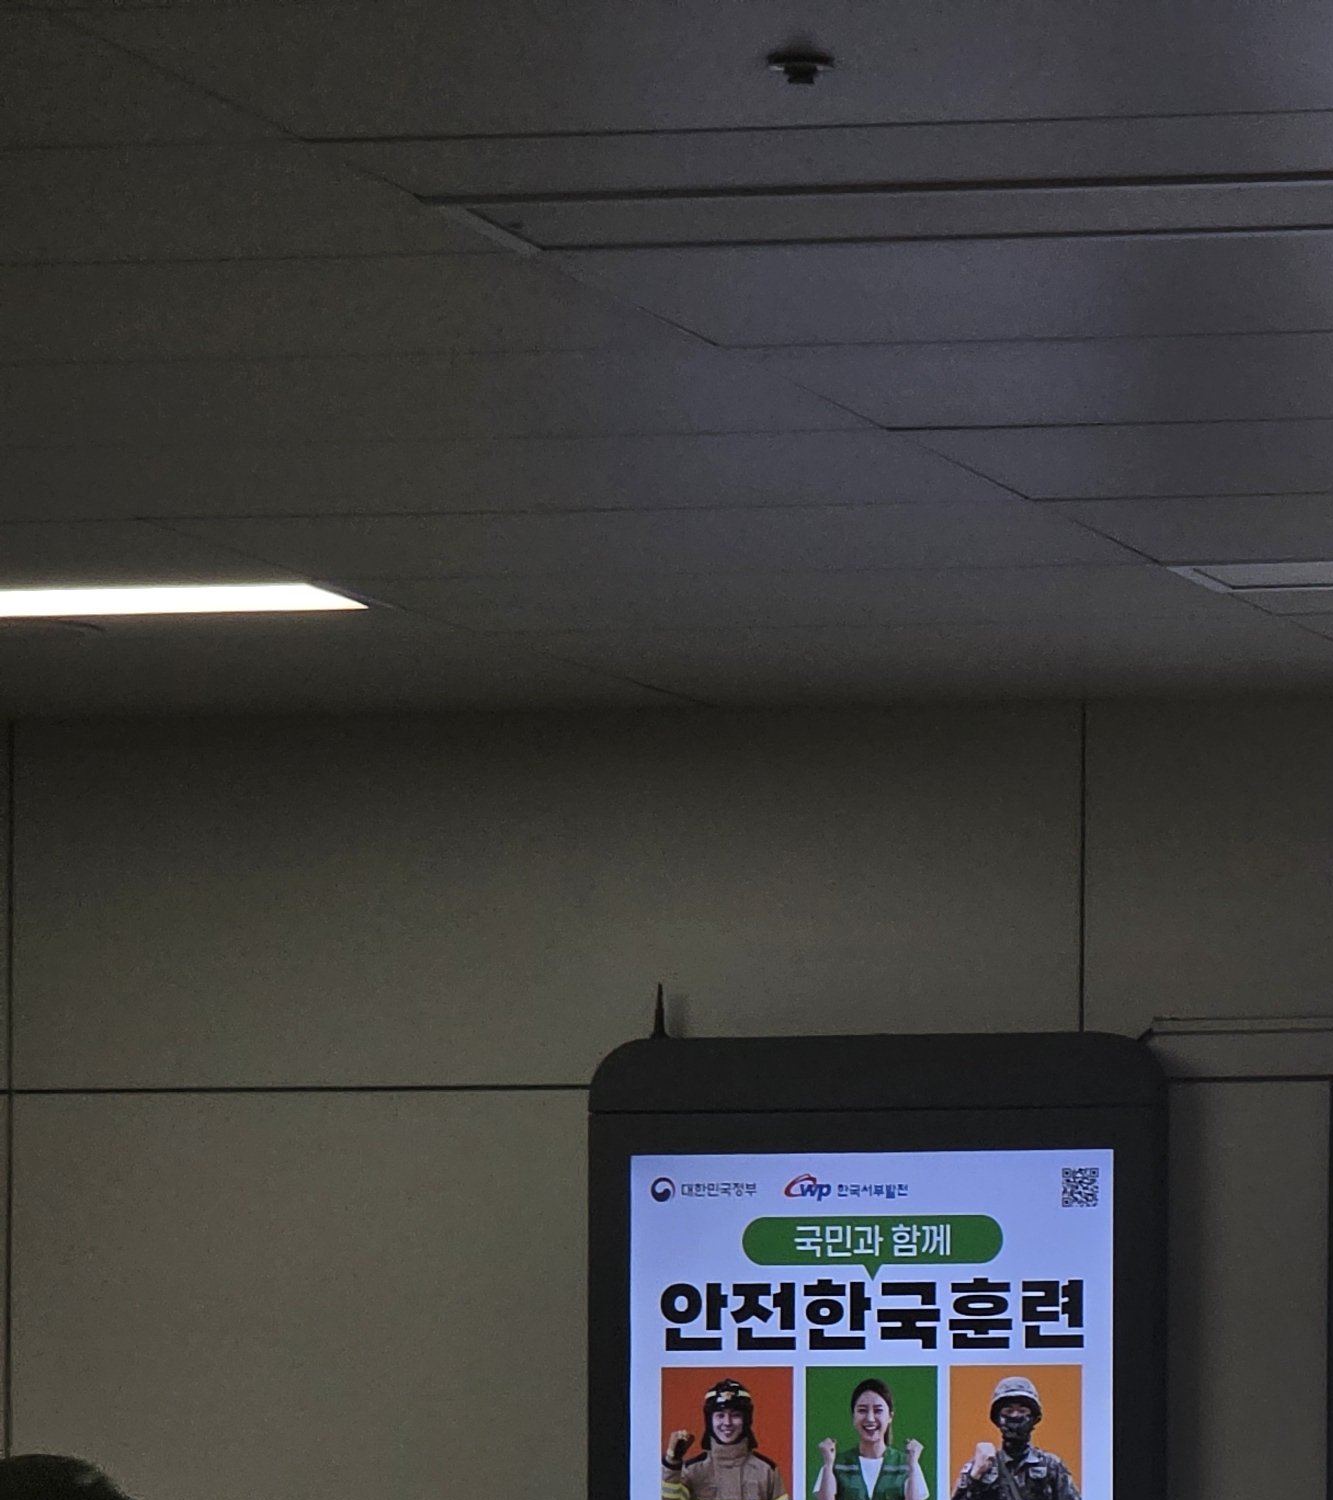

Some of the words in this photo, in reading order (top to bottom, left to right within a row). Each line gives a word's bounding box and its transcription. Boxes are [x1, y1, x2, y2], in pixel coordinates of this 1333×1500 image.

[681, 1180, 756, 1198] 대한민국정부
[837, 1183, 908, 1200] 한국서부발전
[794, 1224, 883, 1258] 국민과
[892, 1224, 952, 1257] 함께
[661, 1277, 1084, 1351] 안전한국훈련
